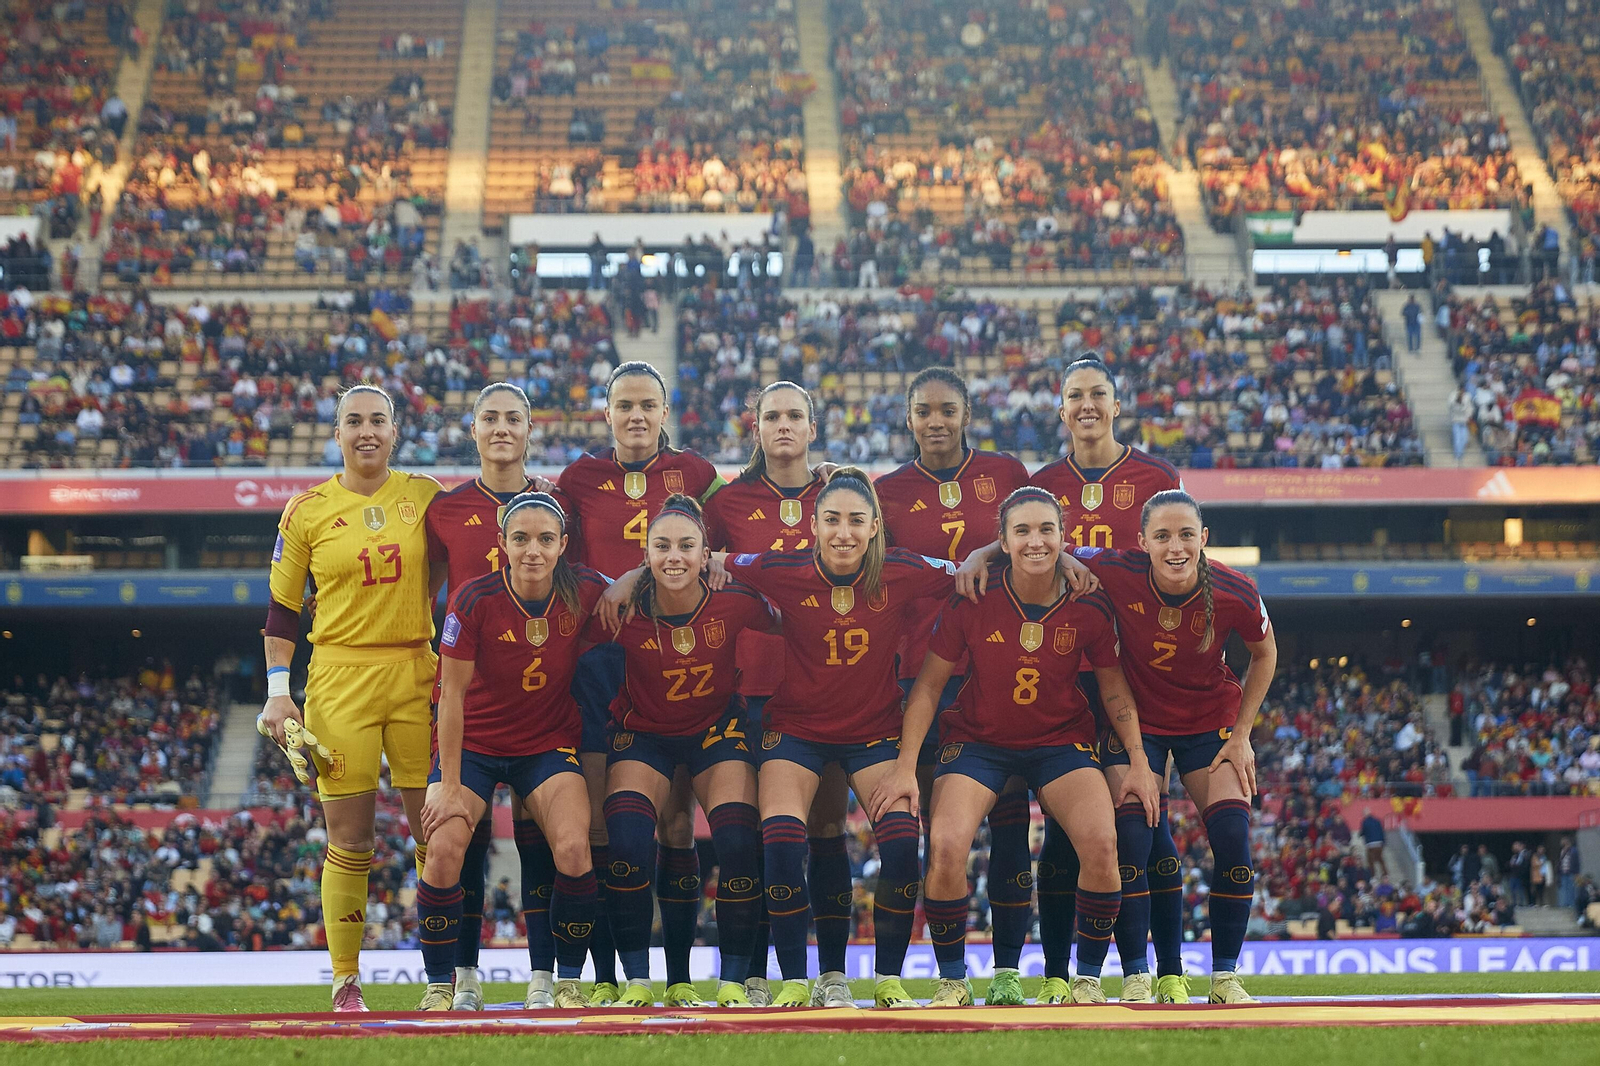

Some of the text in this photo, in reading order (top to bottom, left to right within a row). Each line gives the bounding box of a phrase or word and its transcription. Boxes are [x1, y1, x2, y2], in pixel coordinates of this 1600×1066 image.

[624, 509, 648, 549] 4
[941, 520, 966, 561] 7
[1070, 524, 1113, 549] 10
[357, 543, 402, 587] 13
[822, 627, 869, 666] 19
[1148, 640, 1178, 672] 2
[522, 657, 548, 693] 6
[662, 662, 716, 701] 22
[1012, 667, 1041, 705] 8
[0, 972, 101, 987] TORY
